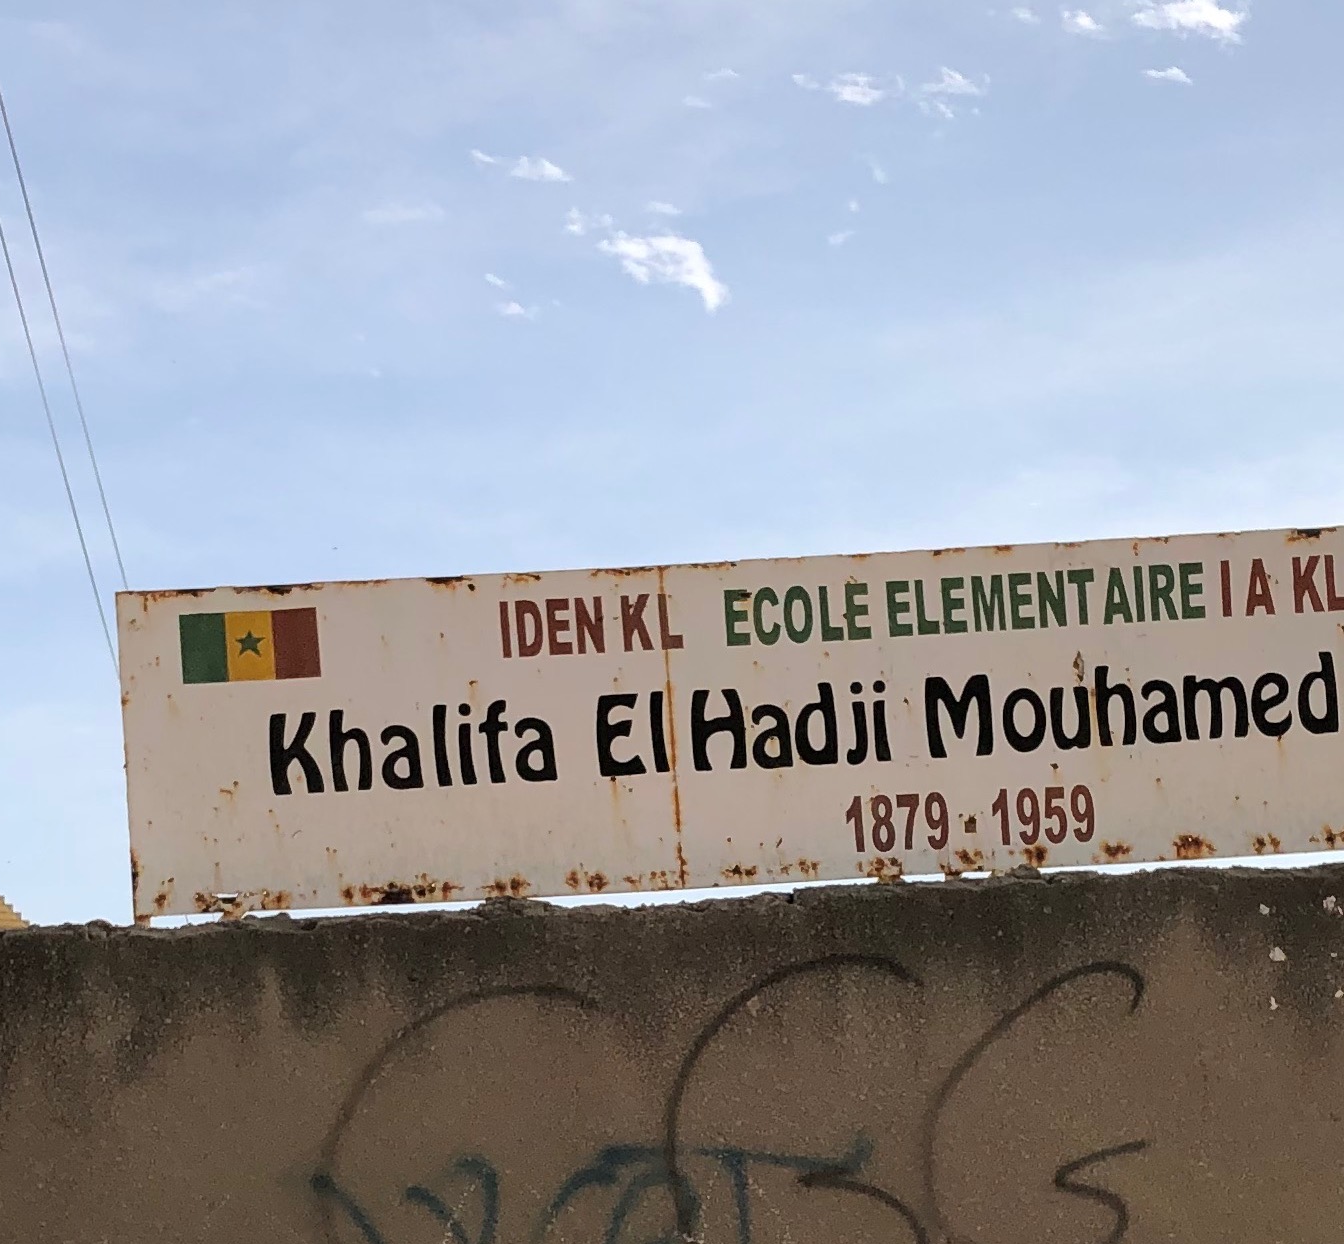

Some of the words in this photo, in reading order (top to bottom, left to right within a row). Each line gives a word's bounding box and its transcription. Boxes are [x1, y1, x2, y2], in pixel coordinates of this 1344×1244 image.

[500, 595, 605, 659] IDEN
[620, 592, 684, 652] KL
[724, 580, 872, 647] ECOLE
[886, 561, 1206, 638] ELEMENTAIRE
[269, 699, 558, 795] Khalifa
[597, 692, 670, 776] El
[691, 680, 892, 771] Hadji
[925, 652, 1340, 758] Mouhamed
[846, 792, 950, 853] 1879
[991, 785, 1095, 846] 1959
